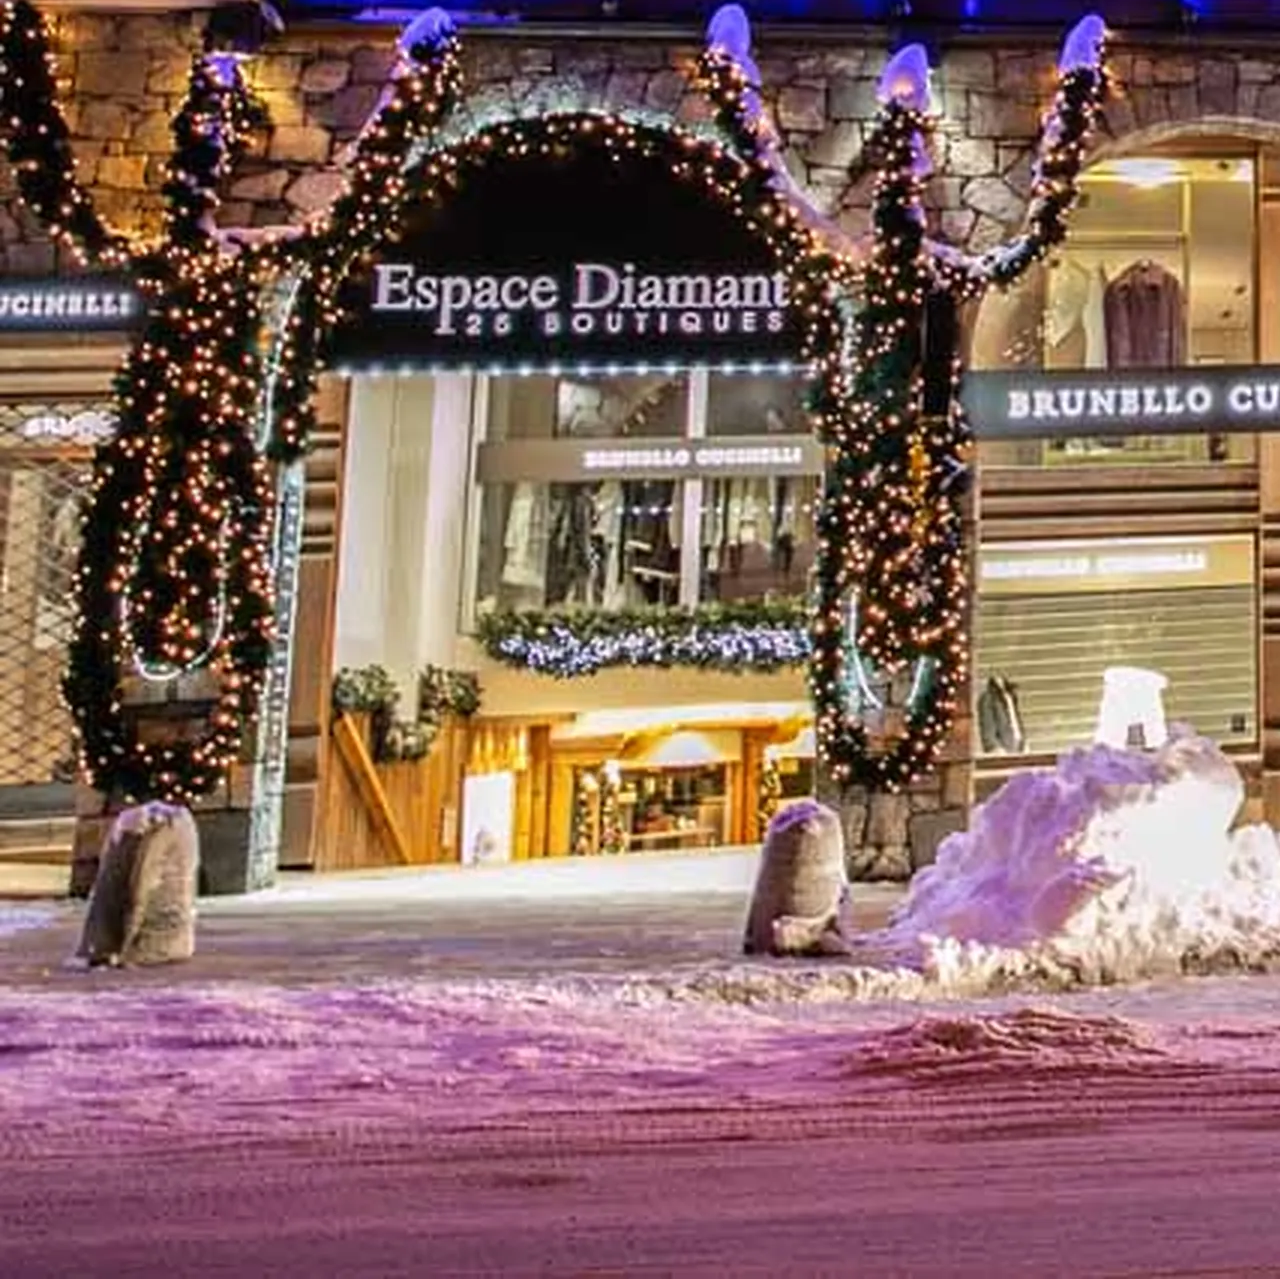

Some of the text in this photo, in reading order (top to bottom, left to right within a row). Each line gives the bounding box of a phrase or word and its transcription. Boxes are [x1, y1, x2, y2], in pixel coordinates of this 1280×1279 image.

[371, 263, 790, 335] Espace Diamant
[544, 311, 784, 333] BOUTIQUES
[1008, 386, 1213, 419] BRUNELLO
